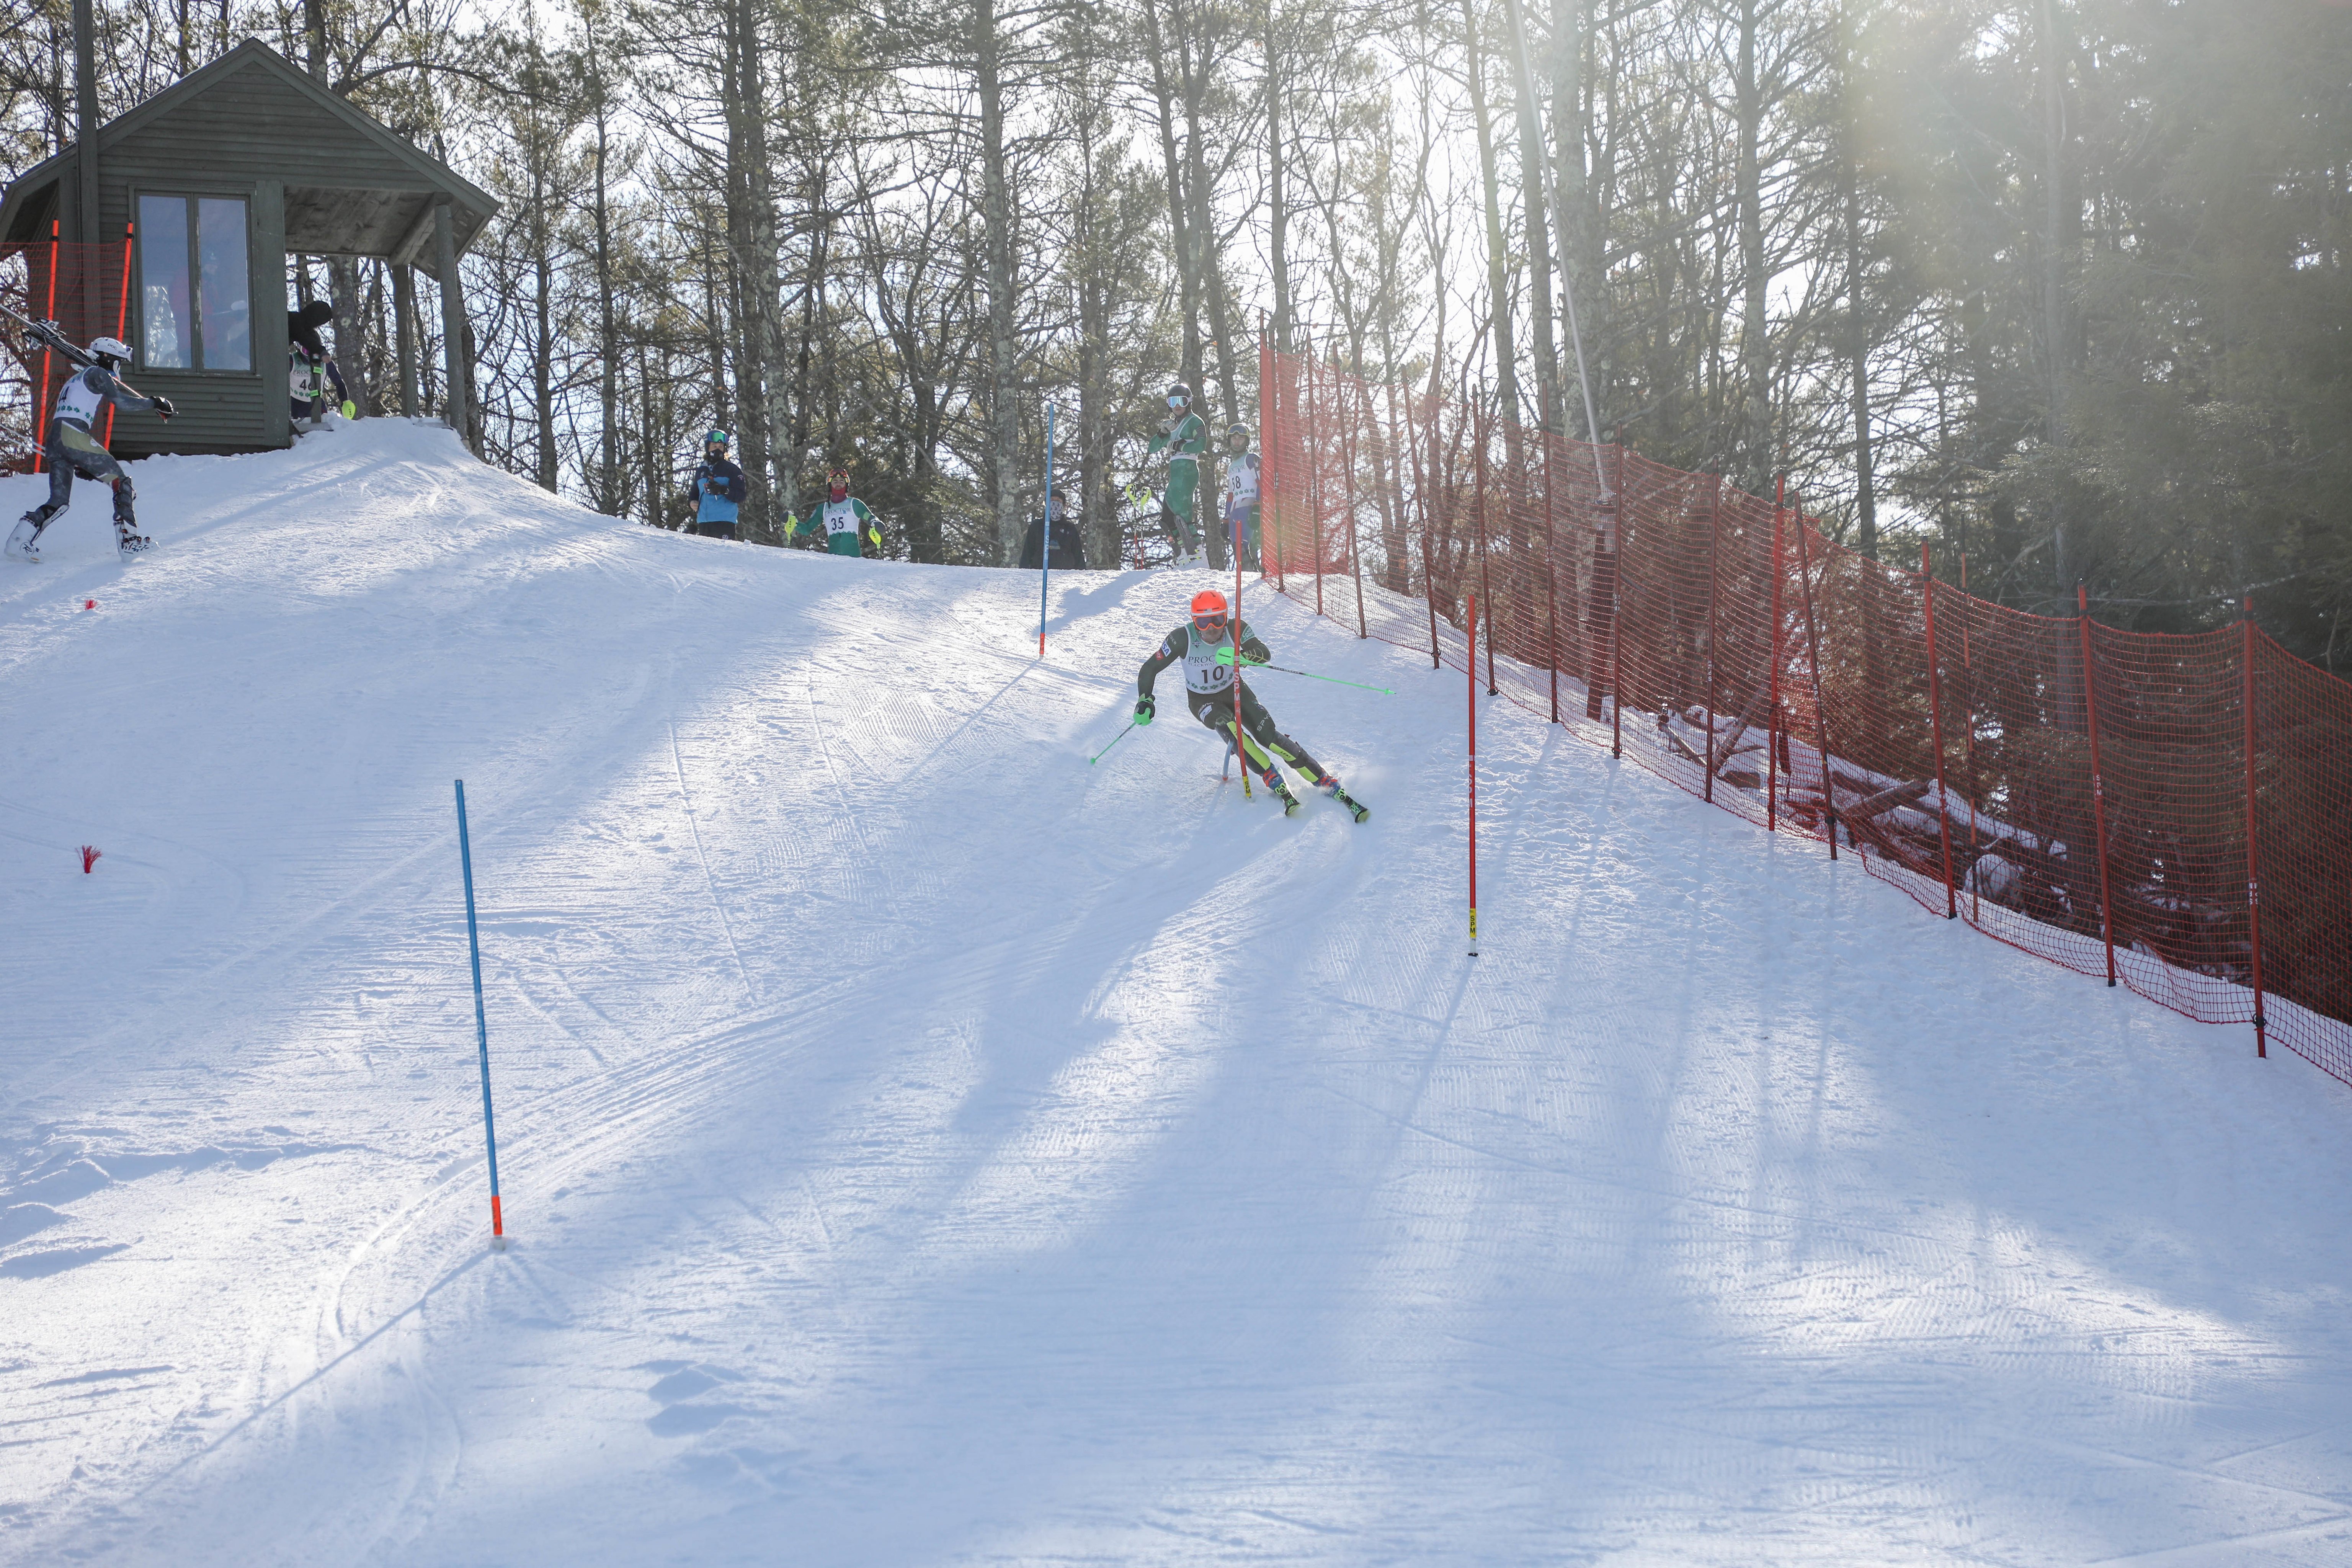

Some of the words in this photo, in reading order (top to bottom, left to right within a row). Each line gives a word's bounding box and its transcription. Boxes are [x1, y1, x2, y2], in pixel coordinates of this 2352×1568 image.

[831, 517, 844, 531] 35
[1188, 655, 1215, 663] PROC
[1201, 666, 1224, 684] 10
